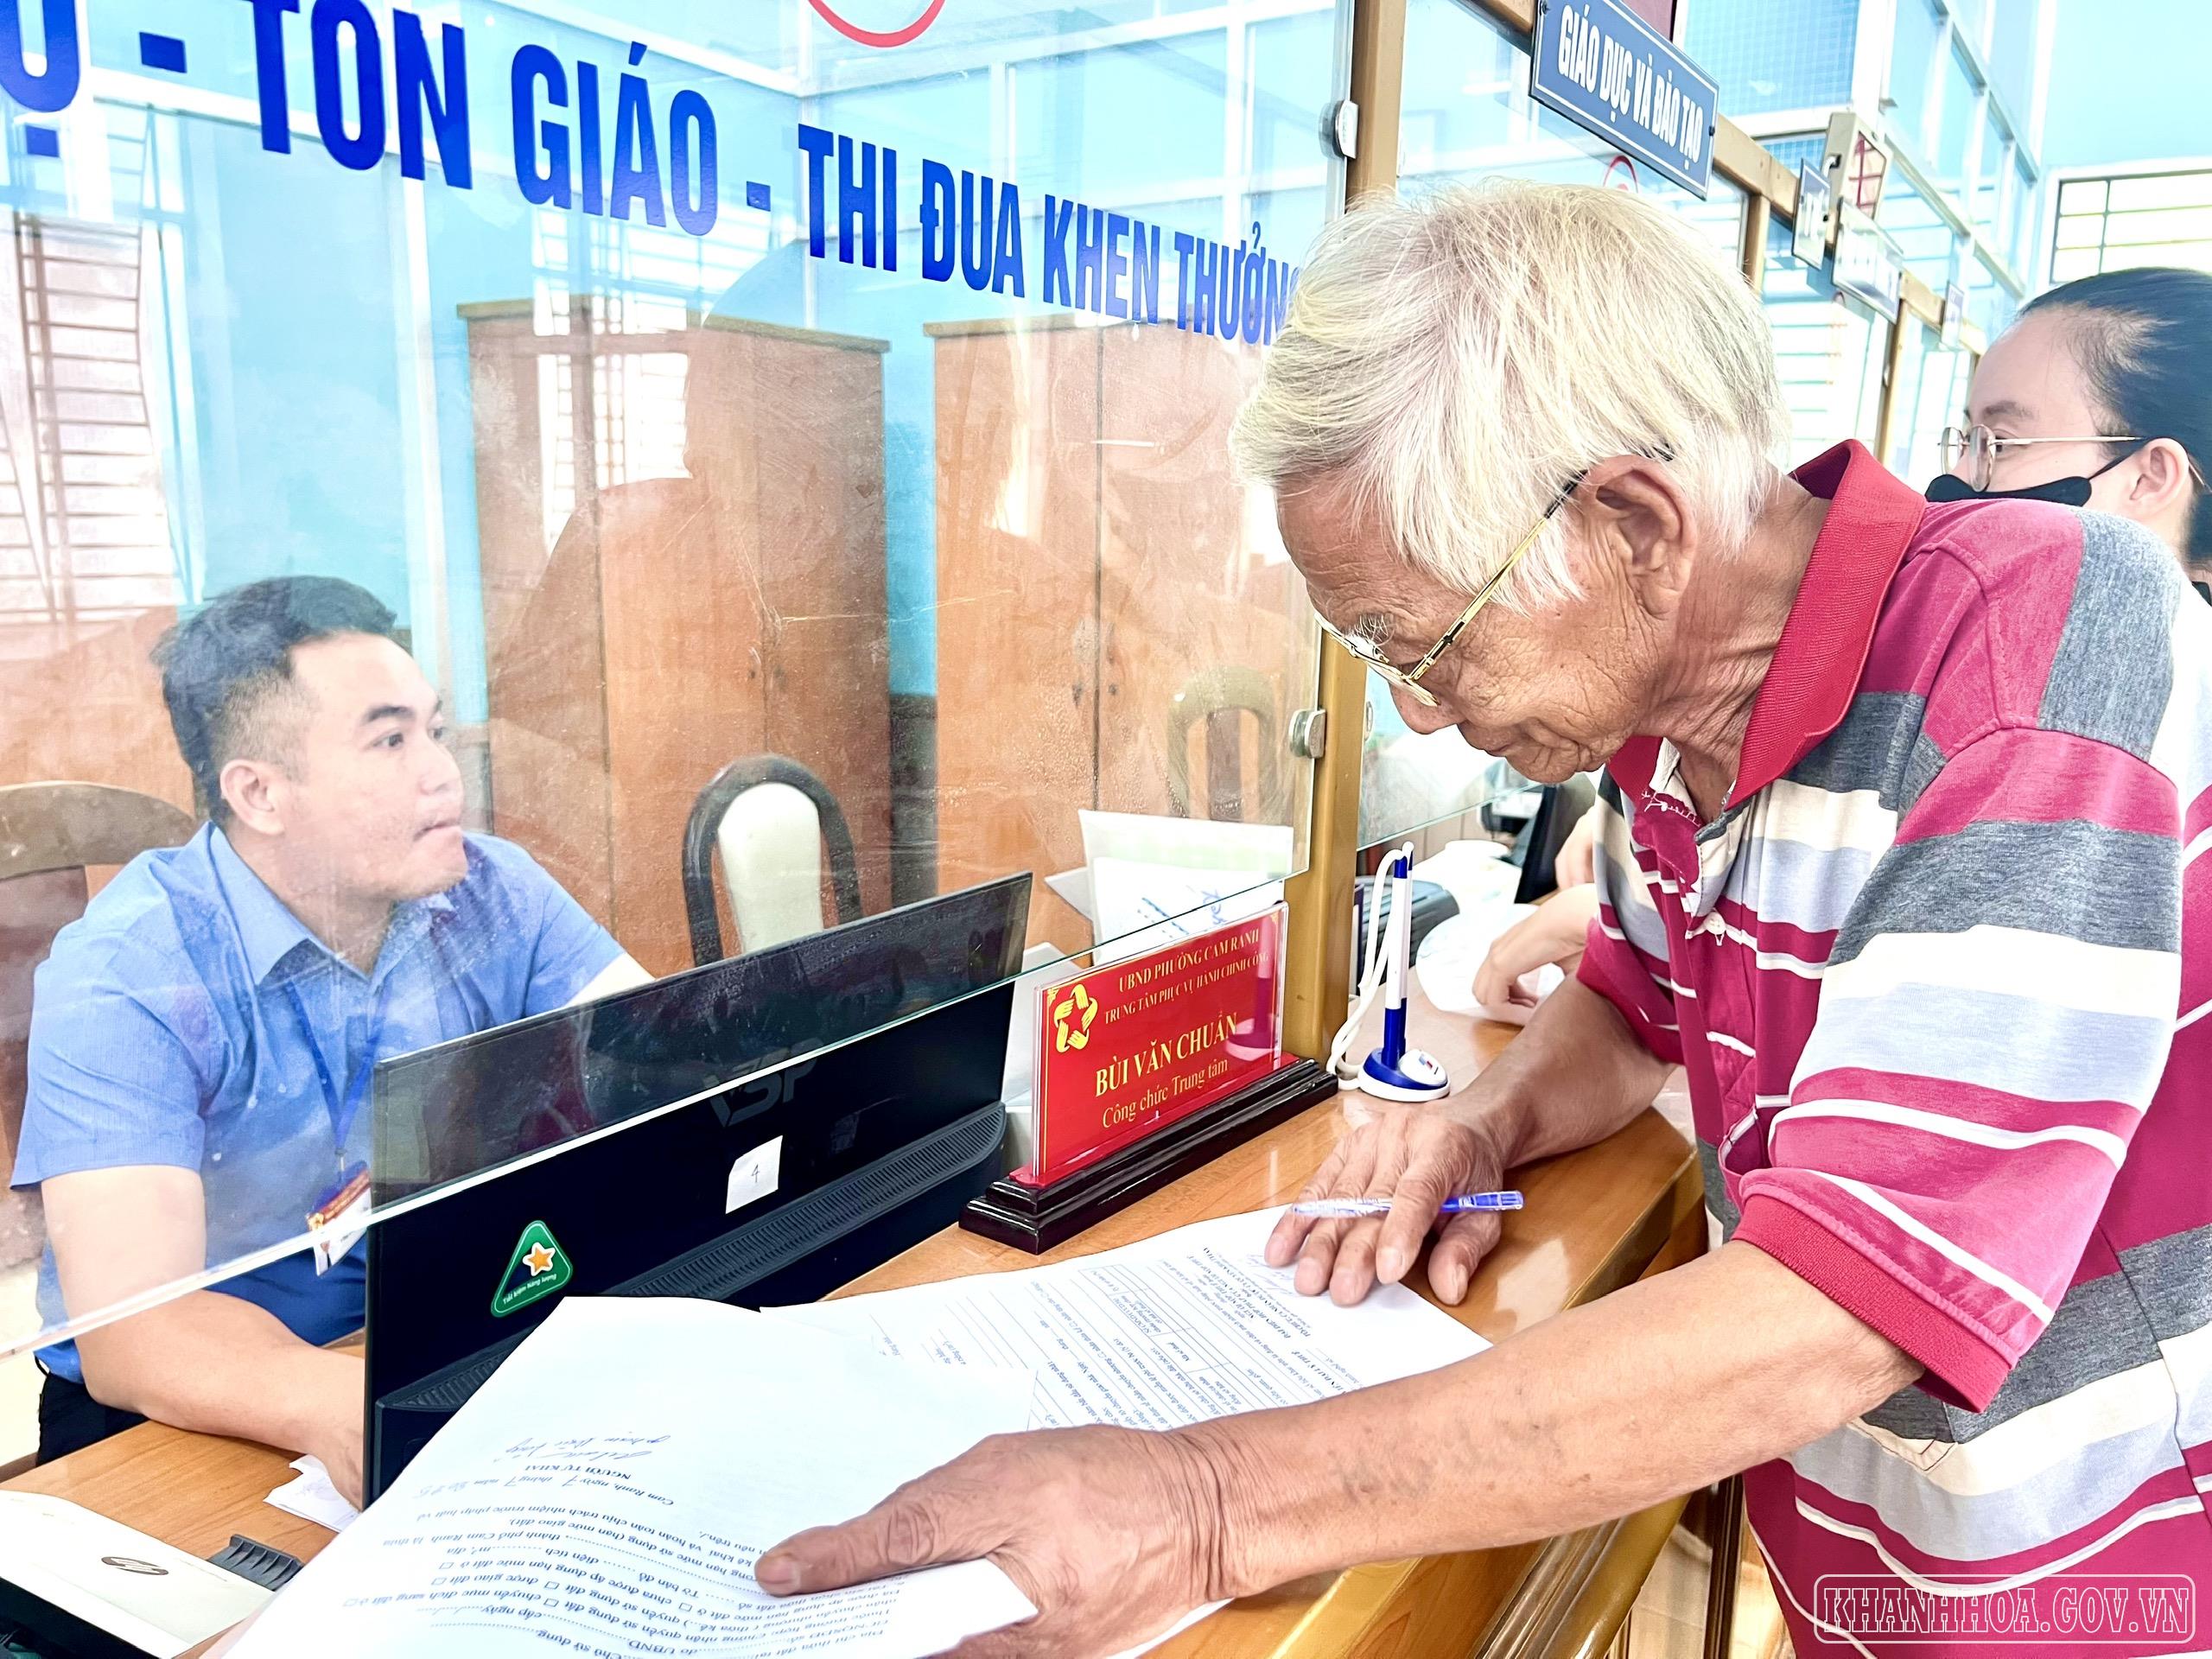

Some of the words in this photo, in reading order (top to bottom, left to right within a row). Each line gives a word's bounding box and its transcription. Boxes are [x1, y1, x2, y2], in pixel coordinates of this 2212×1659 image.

[1558, 4, 1599, 94] GIÁO
[1600, 34, 1633, 123] DỤC
[1633, 52, 1654, 127] VÀ
[1652, 69, 1681, 148] ĐÀO
[1680, 100, 1704, 170] TẠO
[511, 41, 717, 236] GIÁO
[798, 124, 896, 271] THI
[919, 158, 1026, 298] ĐUA
[1043, 194, 1160, 325] KHEN
[1119, 969, 1153, 993] UBND
[1154, 951, 1203, 981] PHƯỜNG
[1204, 939, 1230, 962] CAM
[1230, 928, 1261, 951] RANH
[1104, 1001, 1137, 1025] TRUNG
[1095, 1055, 1129, 1097] BÙI
[1134, 1039, 1173, 1078] VĂN
[1176, 1010, 1238, 1060] CHUẨN
[1103, 1098, 1136, 1128] Công
[1140, 1084, 1168, 1111] chức
[1171, 1066, 1205, 1105] Trung
[1207, 1058, 1228, 1080] tâm
[751, 1163, 760, 1183] 4
[586, 1467, 631, 1479] NGƯỜI
[648, 1493, 674, 1505] Cam
